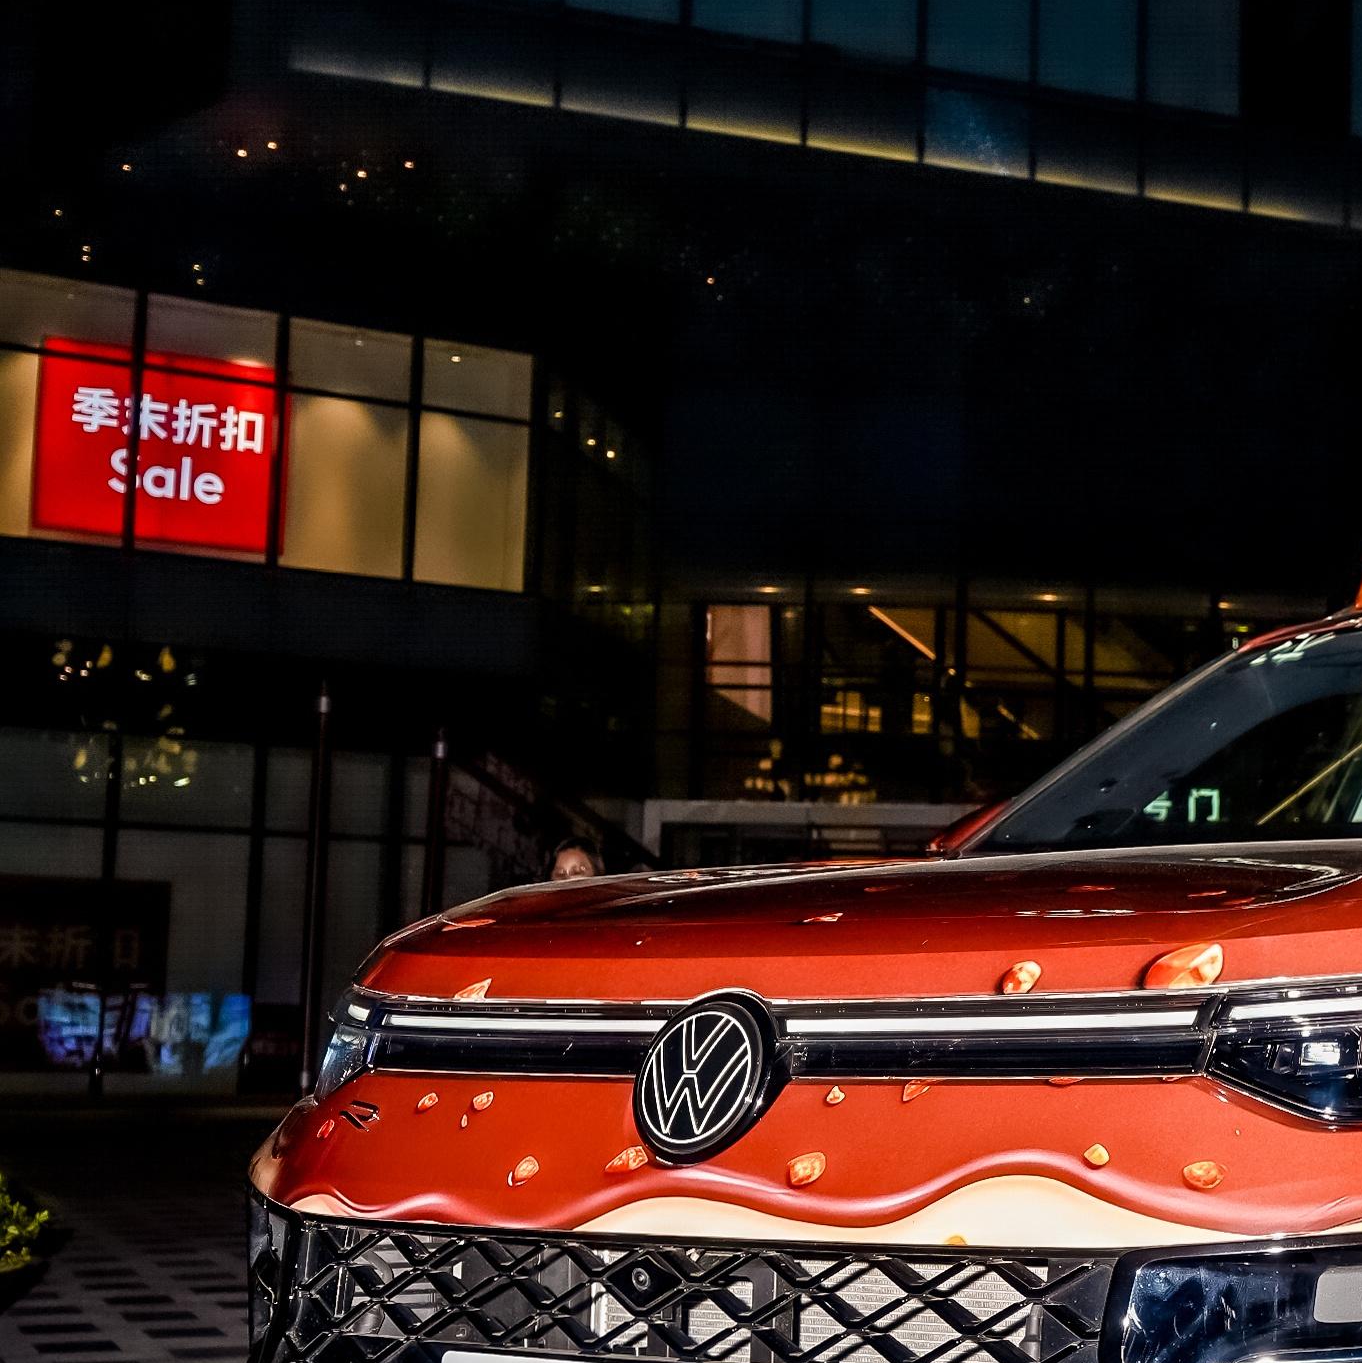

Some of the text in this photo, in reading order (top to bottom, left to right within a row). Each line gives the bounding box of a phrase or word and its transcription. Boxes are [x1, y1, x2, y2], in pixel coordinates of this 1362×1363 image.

[71, 386, 265, 455] 季末折扣
[107, 448, 225, 505] Sale
[641, 1010, 752, 1145] VW
